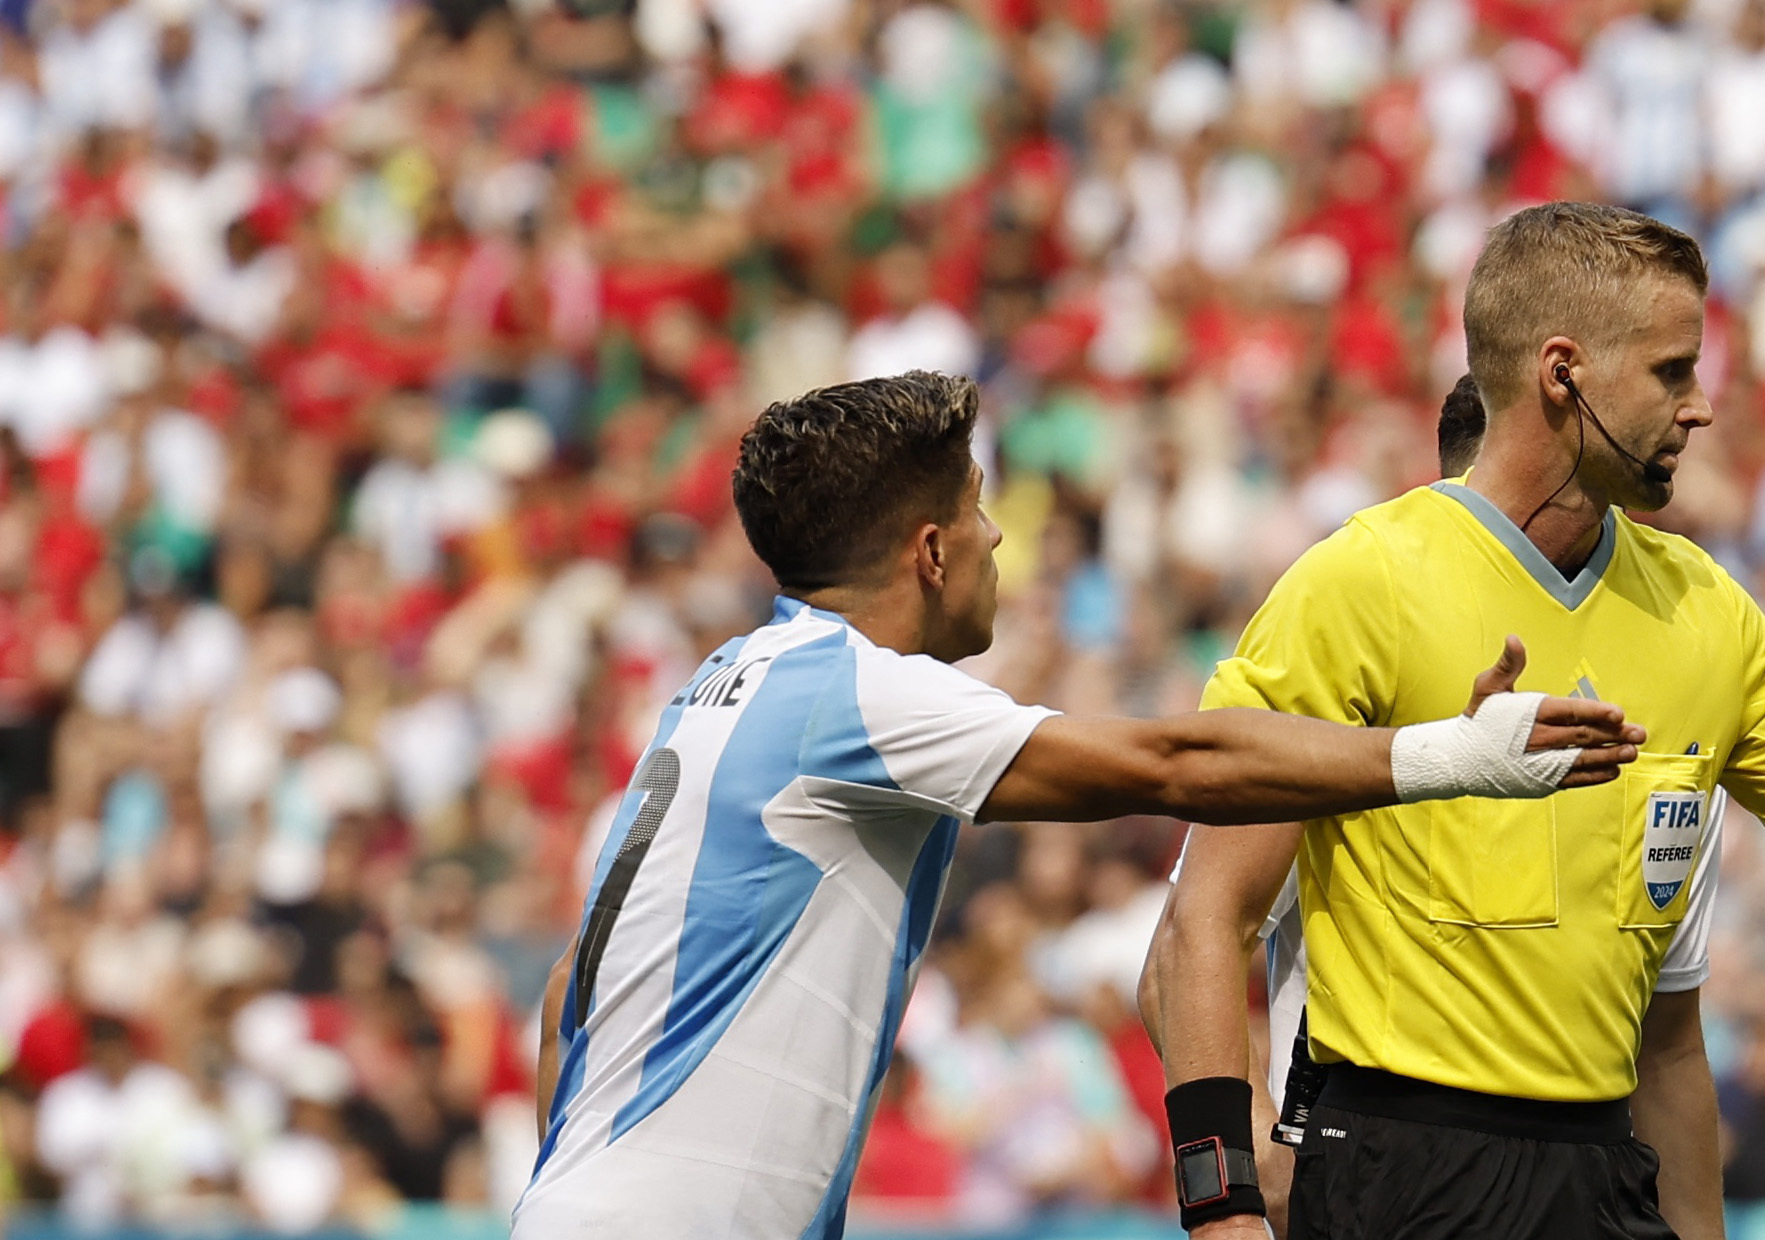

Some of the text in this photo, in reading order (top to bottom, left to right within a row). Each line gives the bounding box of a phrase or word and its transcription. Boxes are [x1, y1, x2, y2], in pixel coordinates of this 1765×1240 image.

[1653, 801, 1699, 828] FIFA
[1647, 846, 1693, 862] REFEREE
[1654, 885, 1674, 899] 2024
